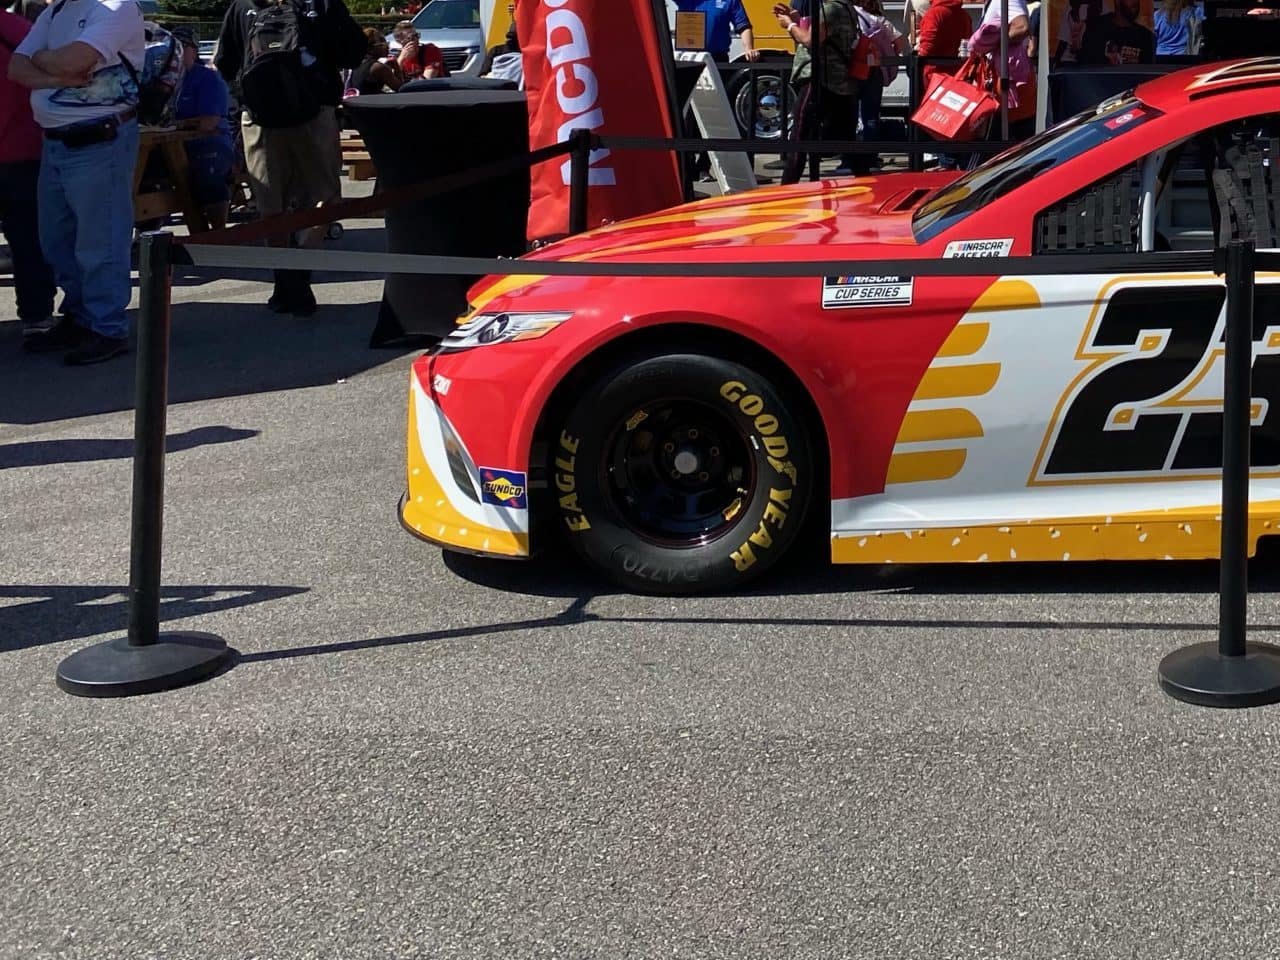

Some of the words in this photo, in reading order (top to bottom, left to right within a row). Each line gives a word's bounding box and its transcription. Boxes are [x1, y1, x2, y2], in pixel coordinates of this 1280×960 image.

[966, 241, 1004, 252] NASCAR
[835, 288, 859, 300] CUP
[860, 287, 901, 298] SERIES
[555, 429, 592, 532] EAGLE
[484, 482, 524, 497] SUNOCO
